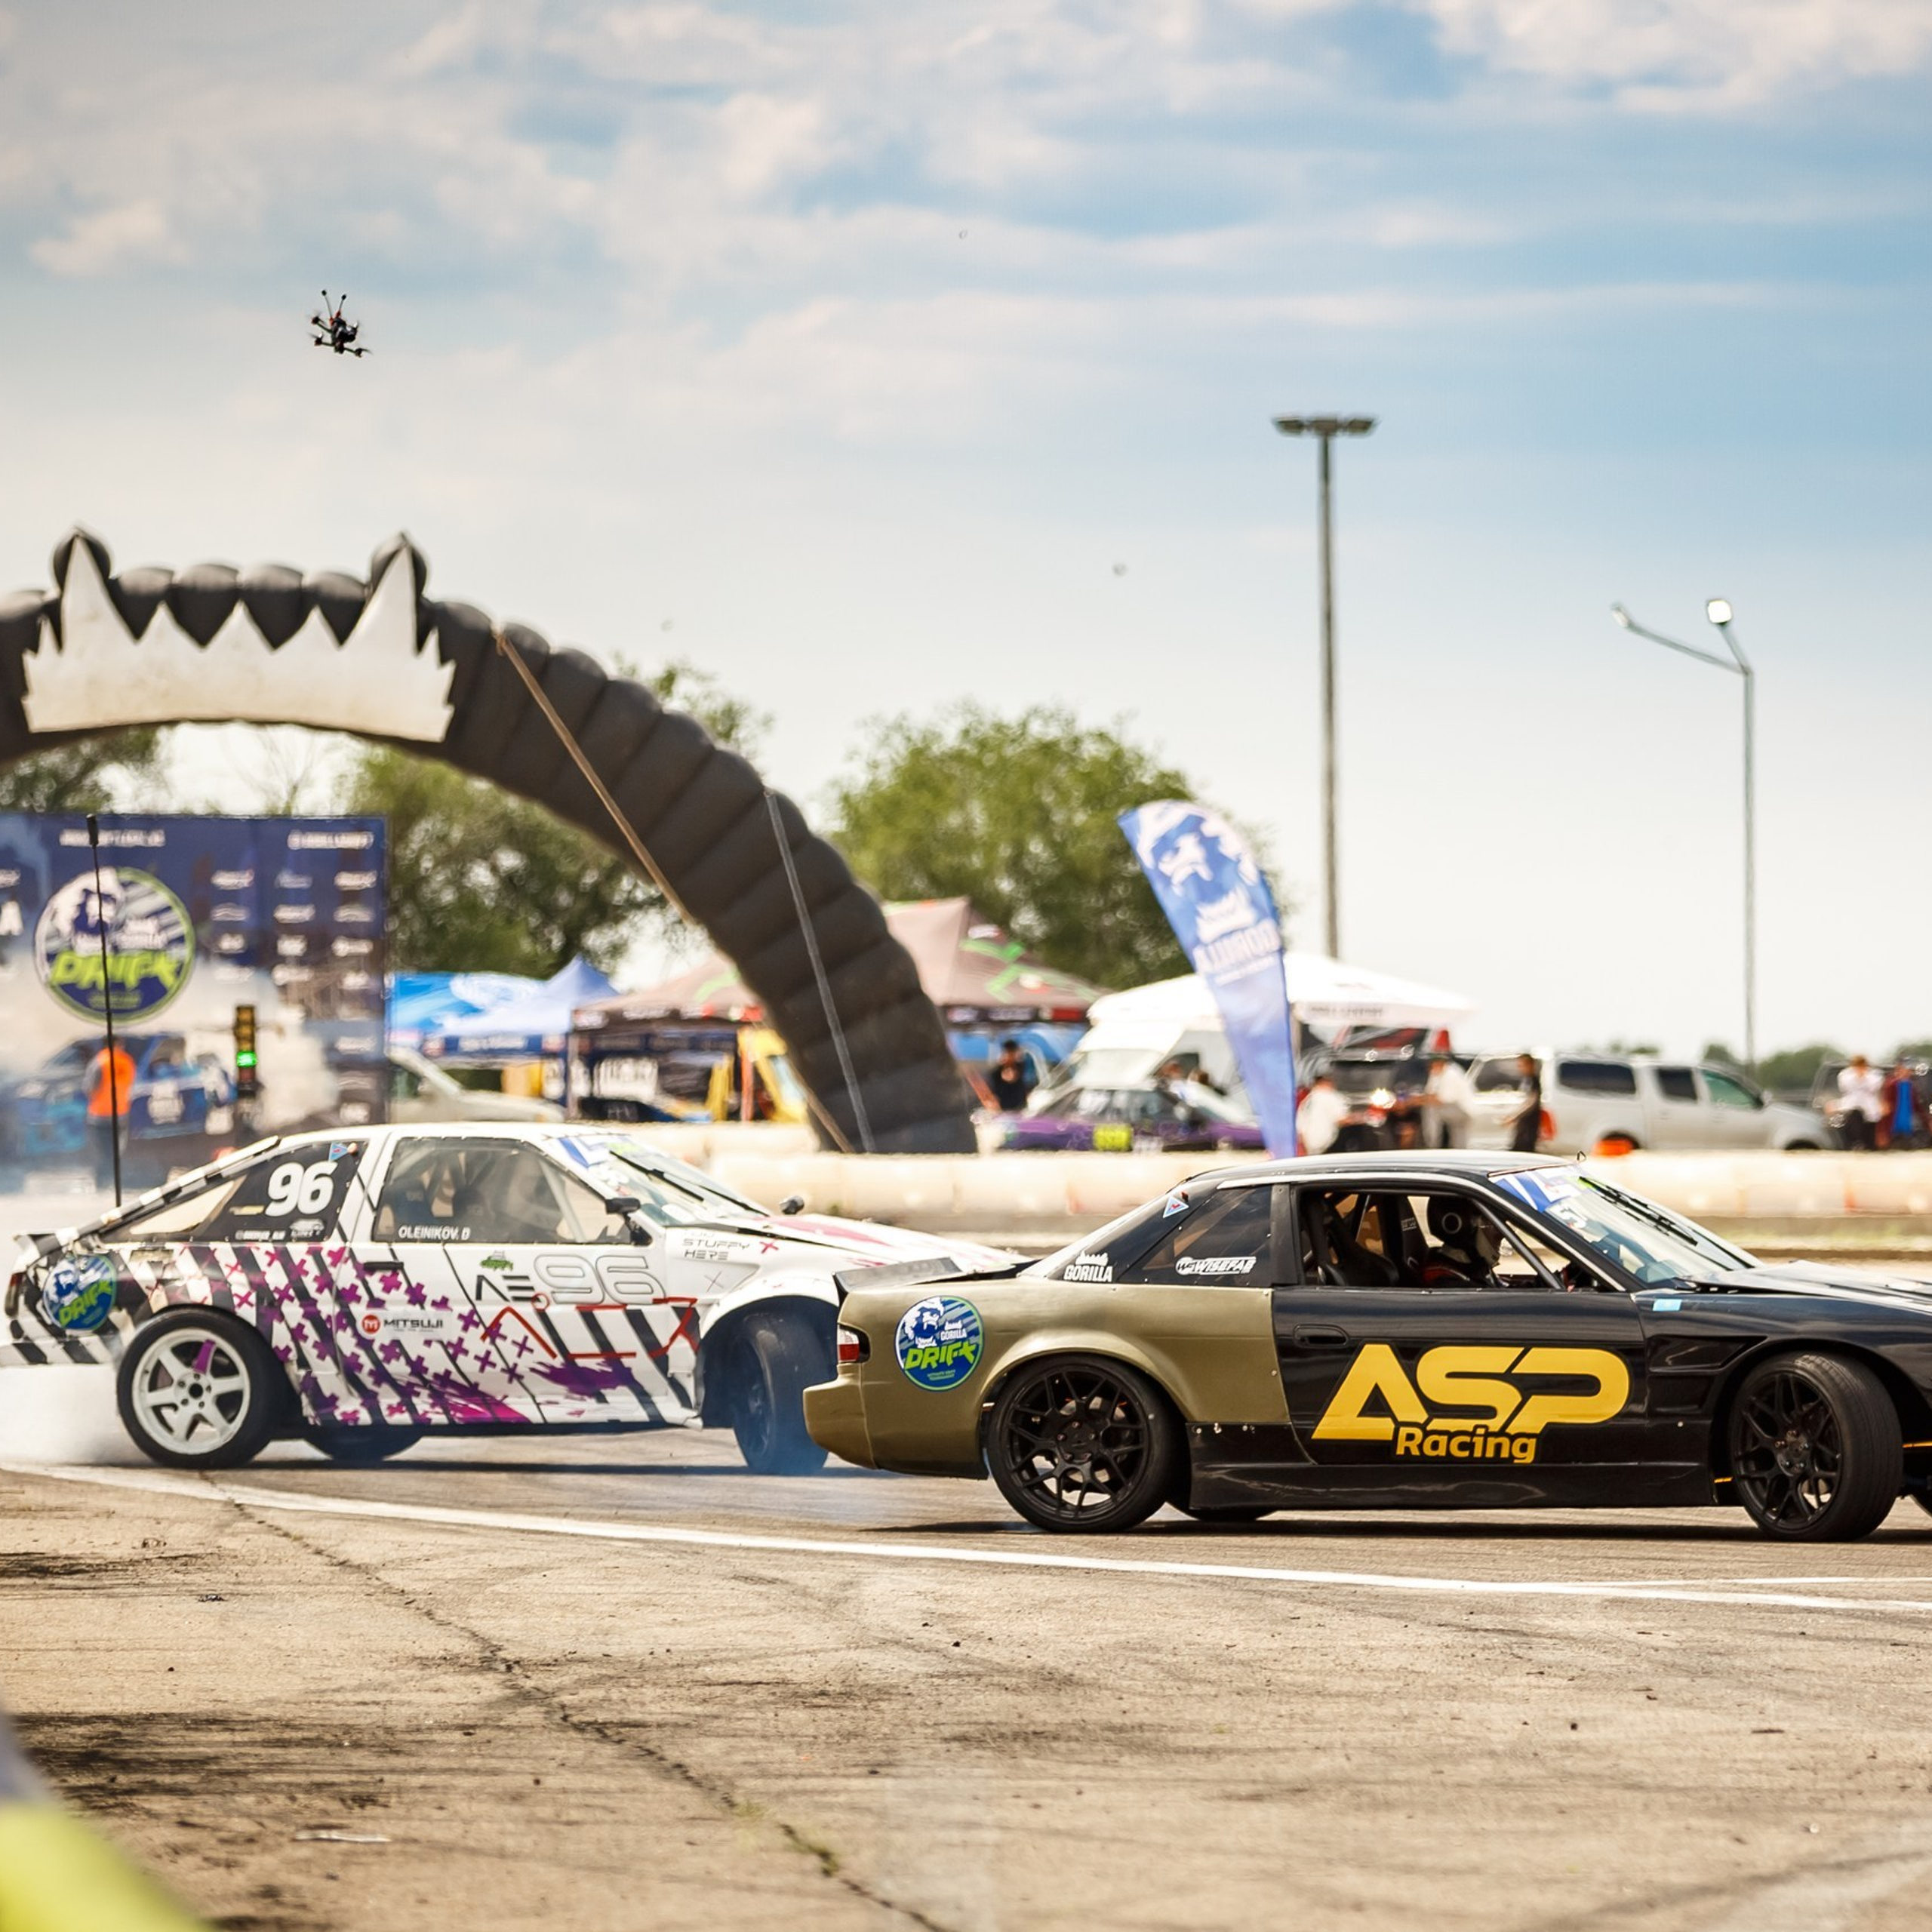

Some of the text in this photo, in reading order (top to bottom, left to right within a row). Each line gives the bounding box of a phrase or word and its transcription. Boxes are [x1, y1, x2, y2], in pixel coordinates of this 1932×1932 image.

[265, 1161, 337, 1217] 96
[684, 1250, 729, 1261] HERE
[1063, 1264, 1113, 1282] GORILLA
[383, 1319, 443, 1328] MITSUJI
[940, 1328, 967, 1341] GORILLA
[1311, 1343, 1630, 1441] ASP
[1395, 1426, 1537, 1464] Racing
